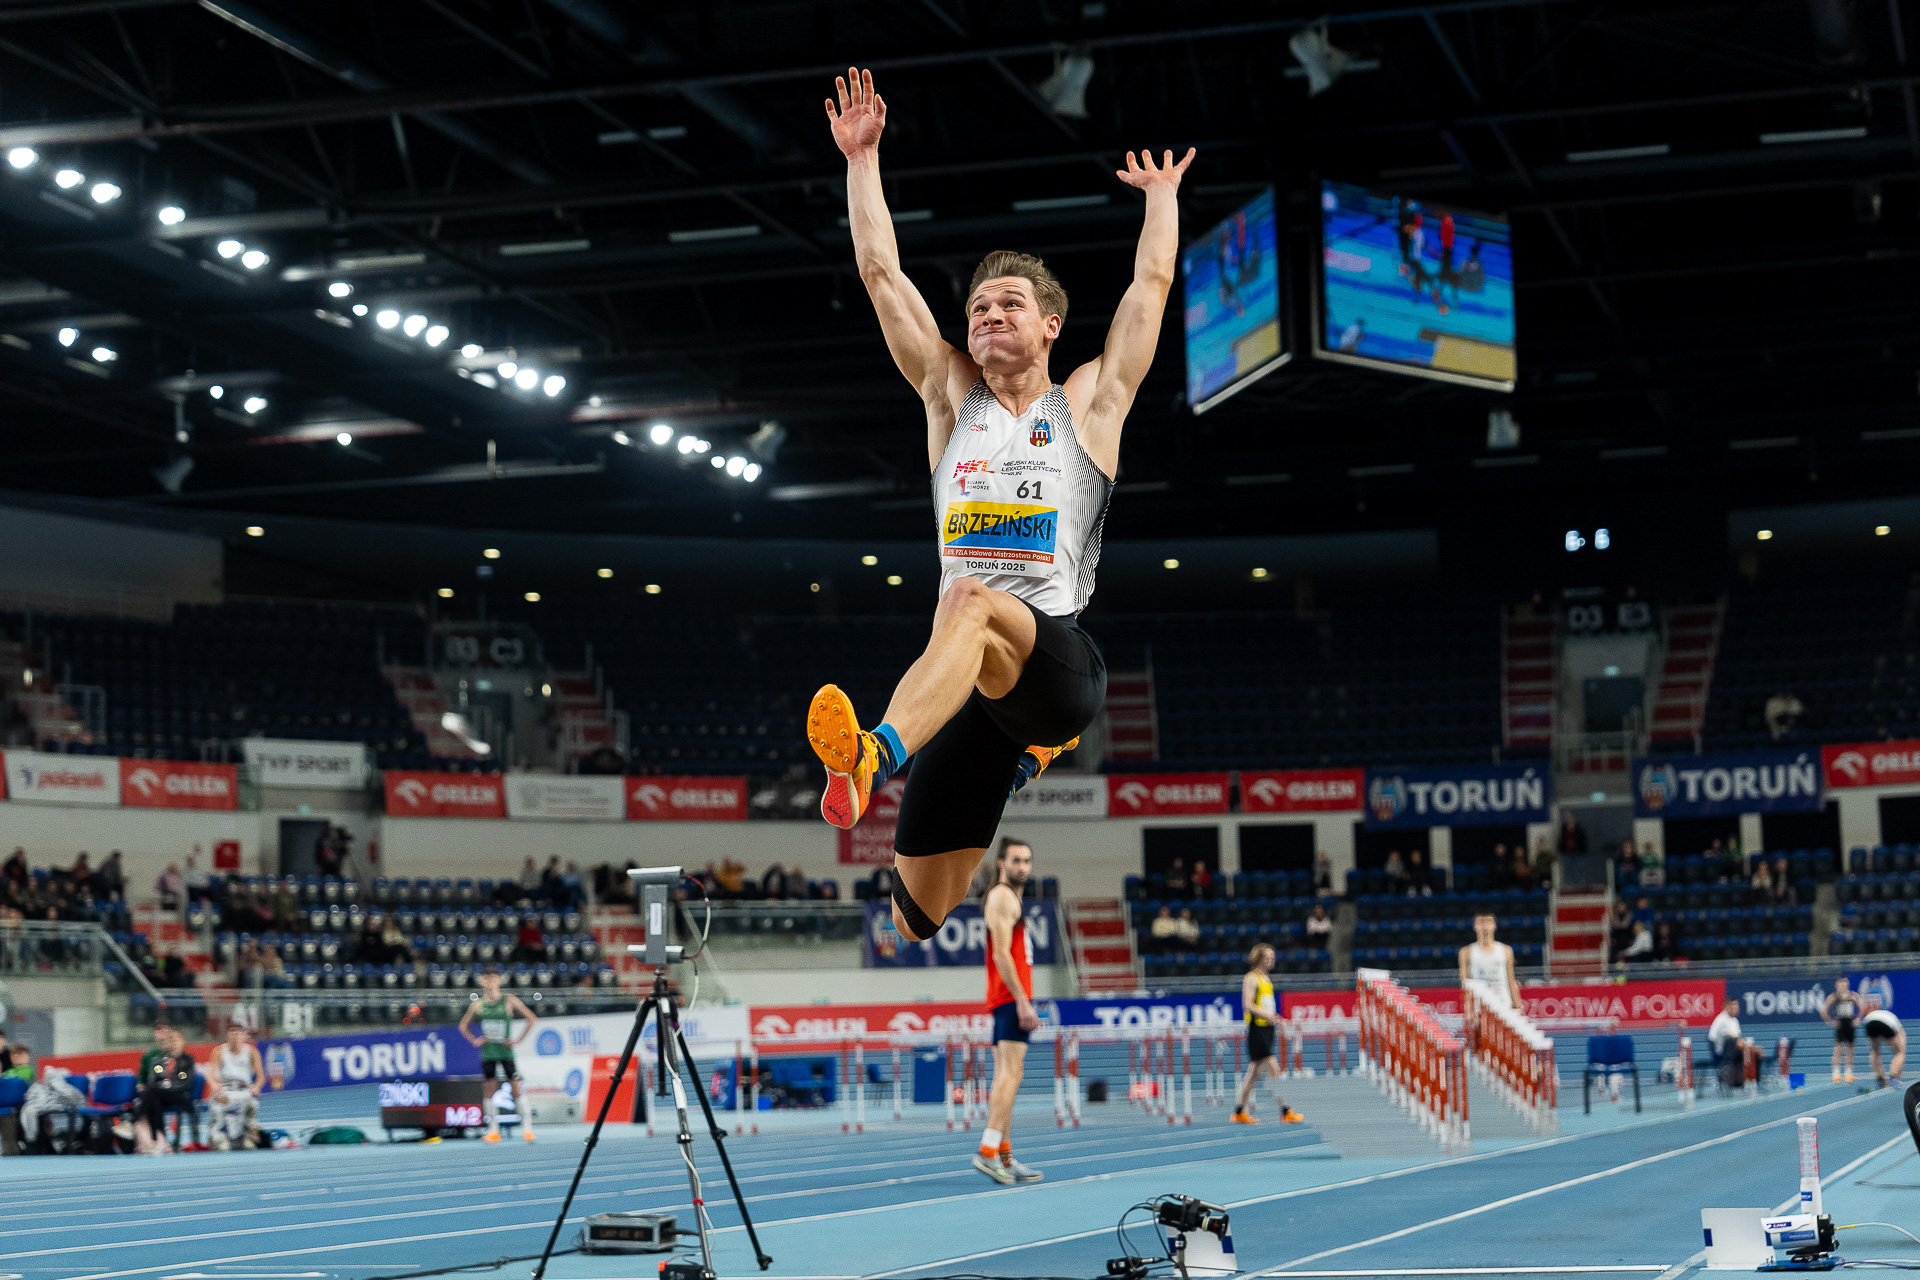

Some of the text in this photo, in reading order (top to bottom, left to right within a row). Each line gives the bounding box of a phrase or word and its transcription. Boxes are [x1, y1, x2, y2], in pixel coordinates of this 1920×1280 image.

[953, 460, 995, 478] MKL
[1016, 480, 1043, 500] 61
[947, 510, 1052, 541] BRZEZIŃSKI
[965, 560, 1026, 572] TORUŃ 2025
[993, 551, 1031, 560] Mistrzostwa
[1032, 553, 1051, 562] Polski
[1871, 752, 1920, 774] ORLE
[165, 774, 230, 796] ORLEN
[1679, 752, 1816, 802] TORUŃ
[431, 783, 498, 804] ORLEN
[670, 789, 738, 808] ORLEN
[1154, 783, 1223, 804] ORLEN
[1287, 779, 1356, 801] ORLEN
[1408, 768, 1544, 814] TORUŃ
[1631, 992, 1715, 1019] POLSKI
[1743, 983, 1826, 1016] TORUŃ
[322, 1032, 447, 1082] TORUŃ
